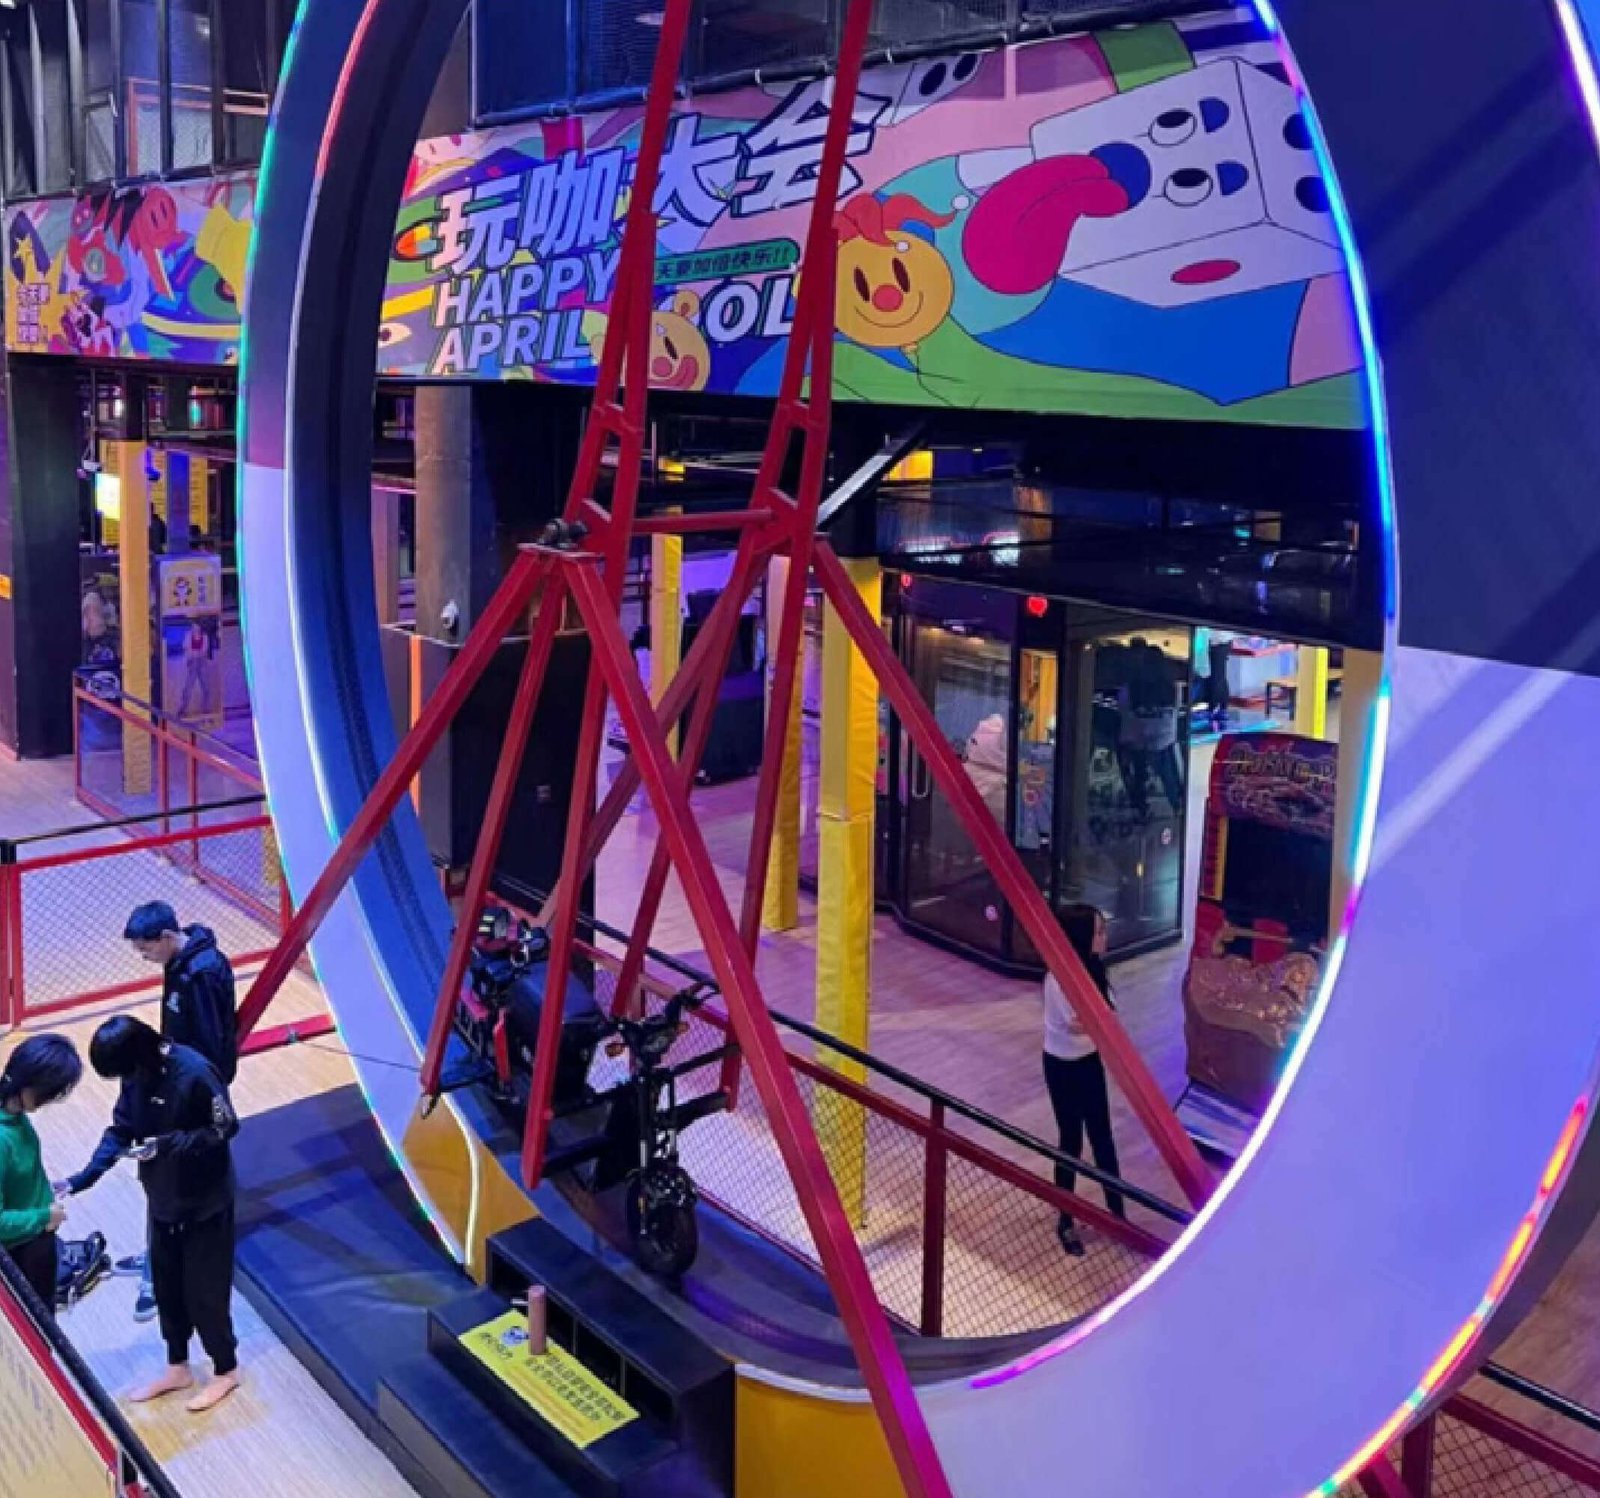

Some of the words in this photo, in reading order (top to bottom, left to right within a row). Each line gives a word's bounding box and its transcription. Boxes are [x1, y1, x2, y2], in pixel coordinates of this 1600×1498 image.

[433, 78, 889, 272] 玩咖大会
[436, 249, 622, 327] HAPPY
[431, 310, 593, 374] APRIL
